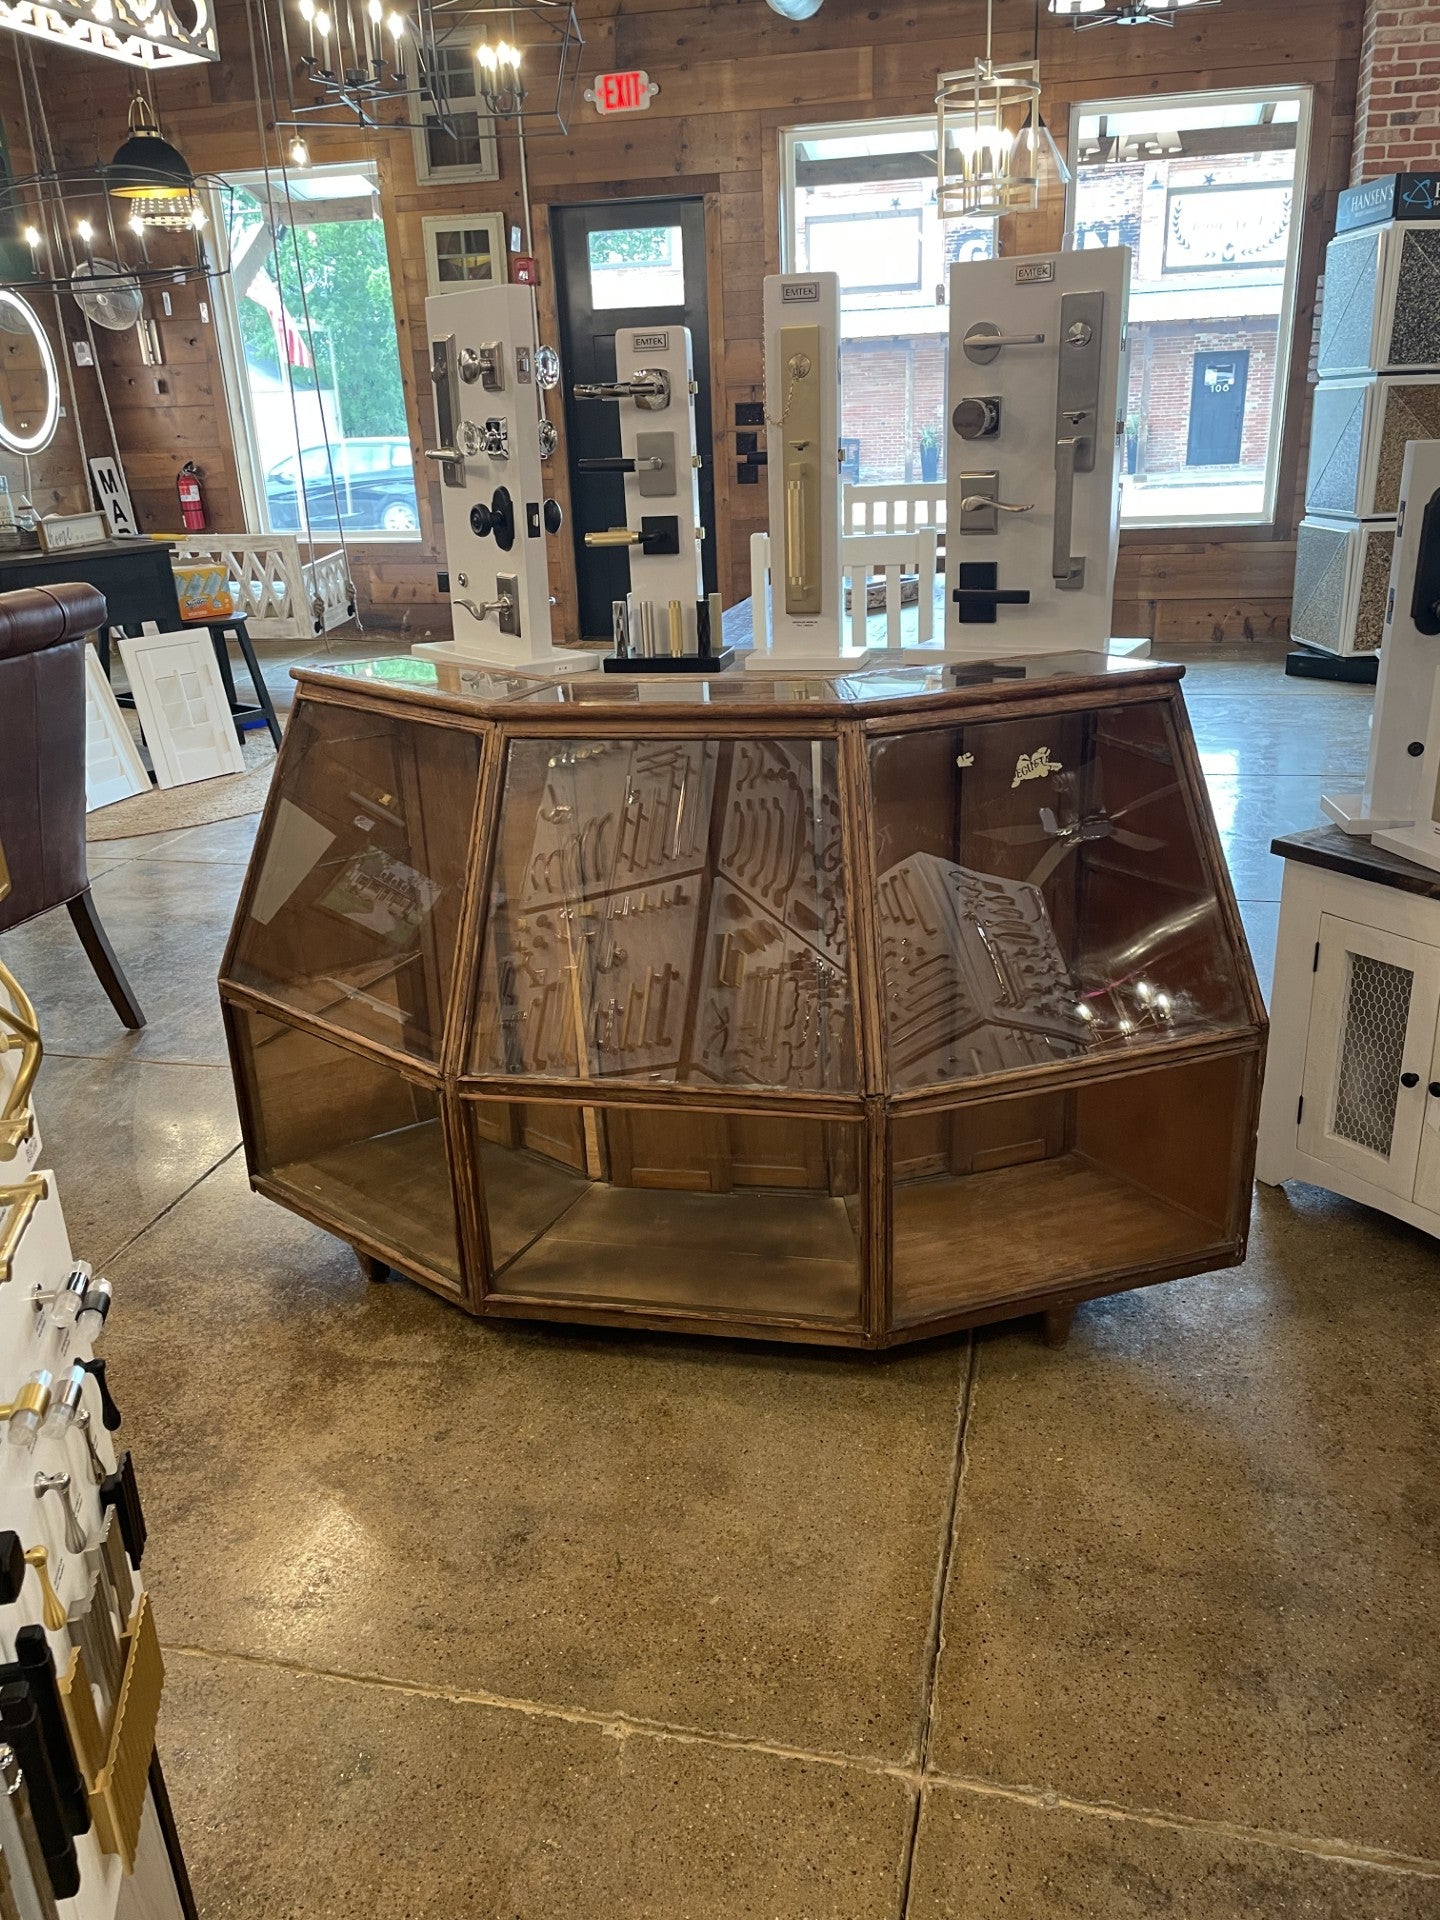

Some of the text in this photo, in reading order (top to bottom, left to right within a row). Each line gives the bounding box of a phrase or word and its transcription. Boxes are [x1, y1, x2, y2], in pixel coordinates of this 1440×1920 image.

[603, 72, 640, 110] EXIT
[1351, 183, 1395, 212] HANSEN'S
[1018, 266, 1048, 278] EMTEK
[785, 287, 814, 297] EMTEK
[635, 337, 663, 346] EMTEK
[1210, 384, 1230, 393] 106
[97, 468, 131, 534] MA
